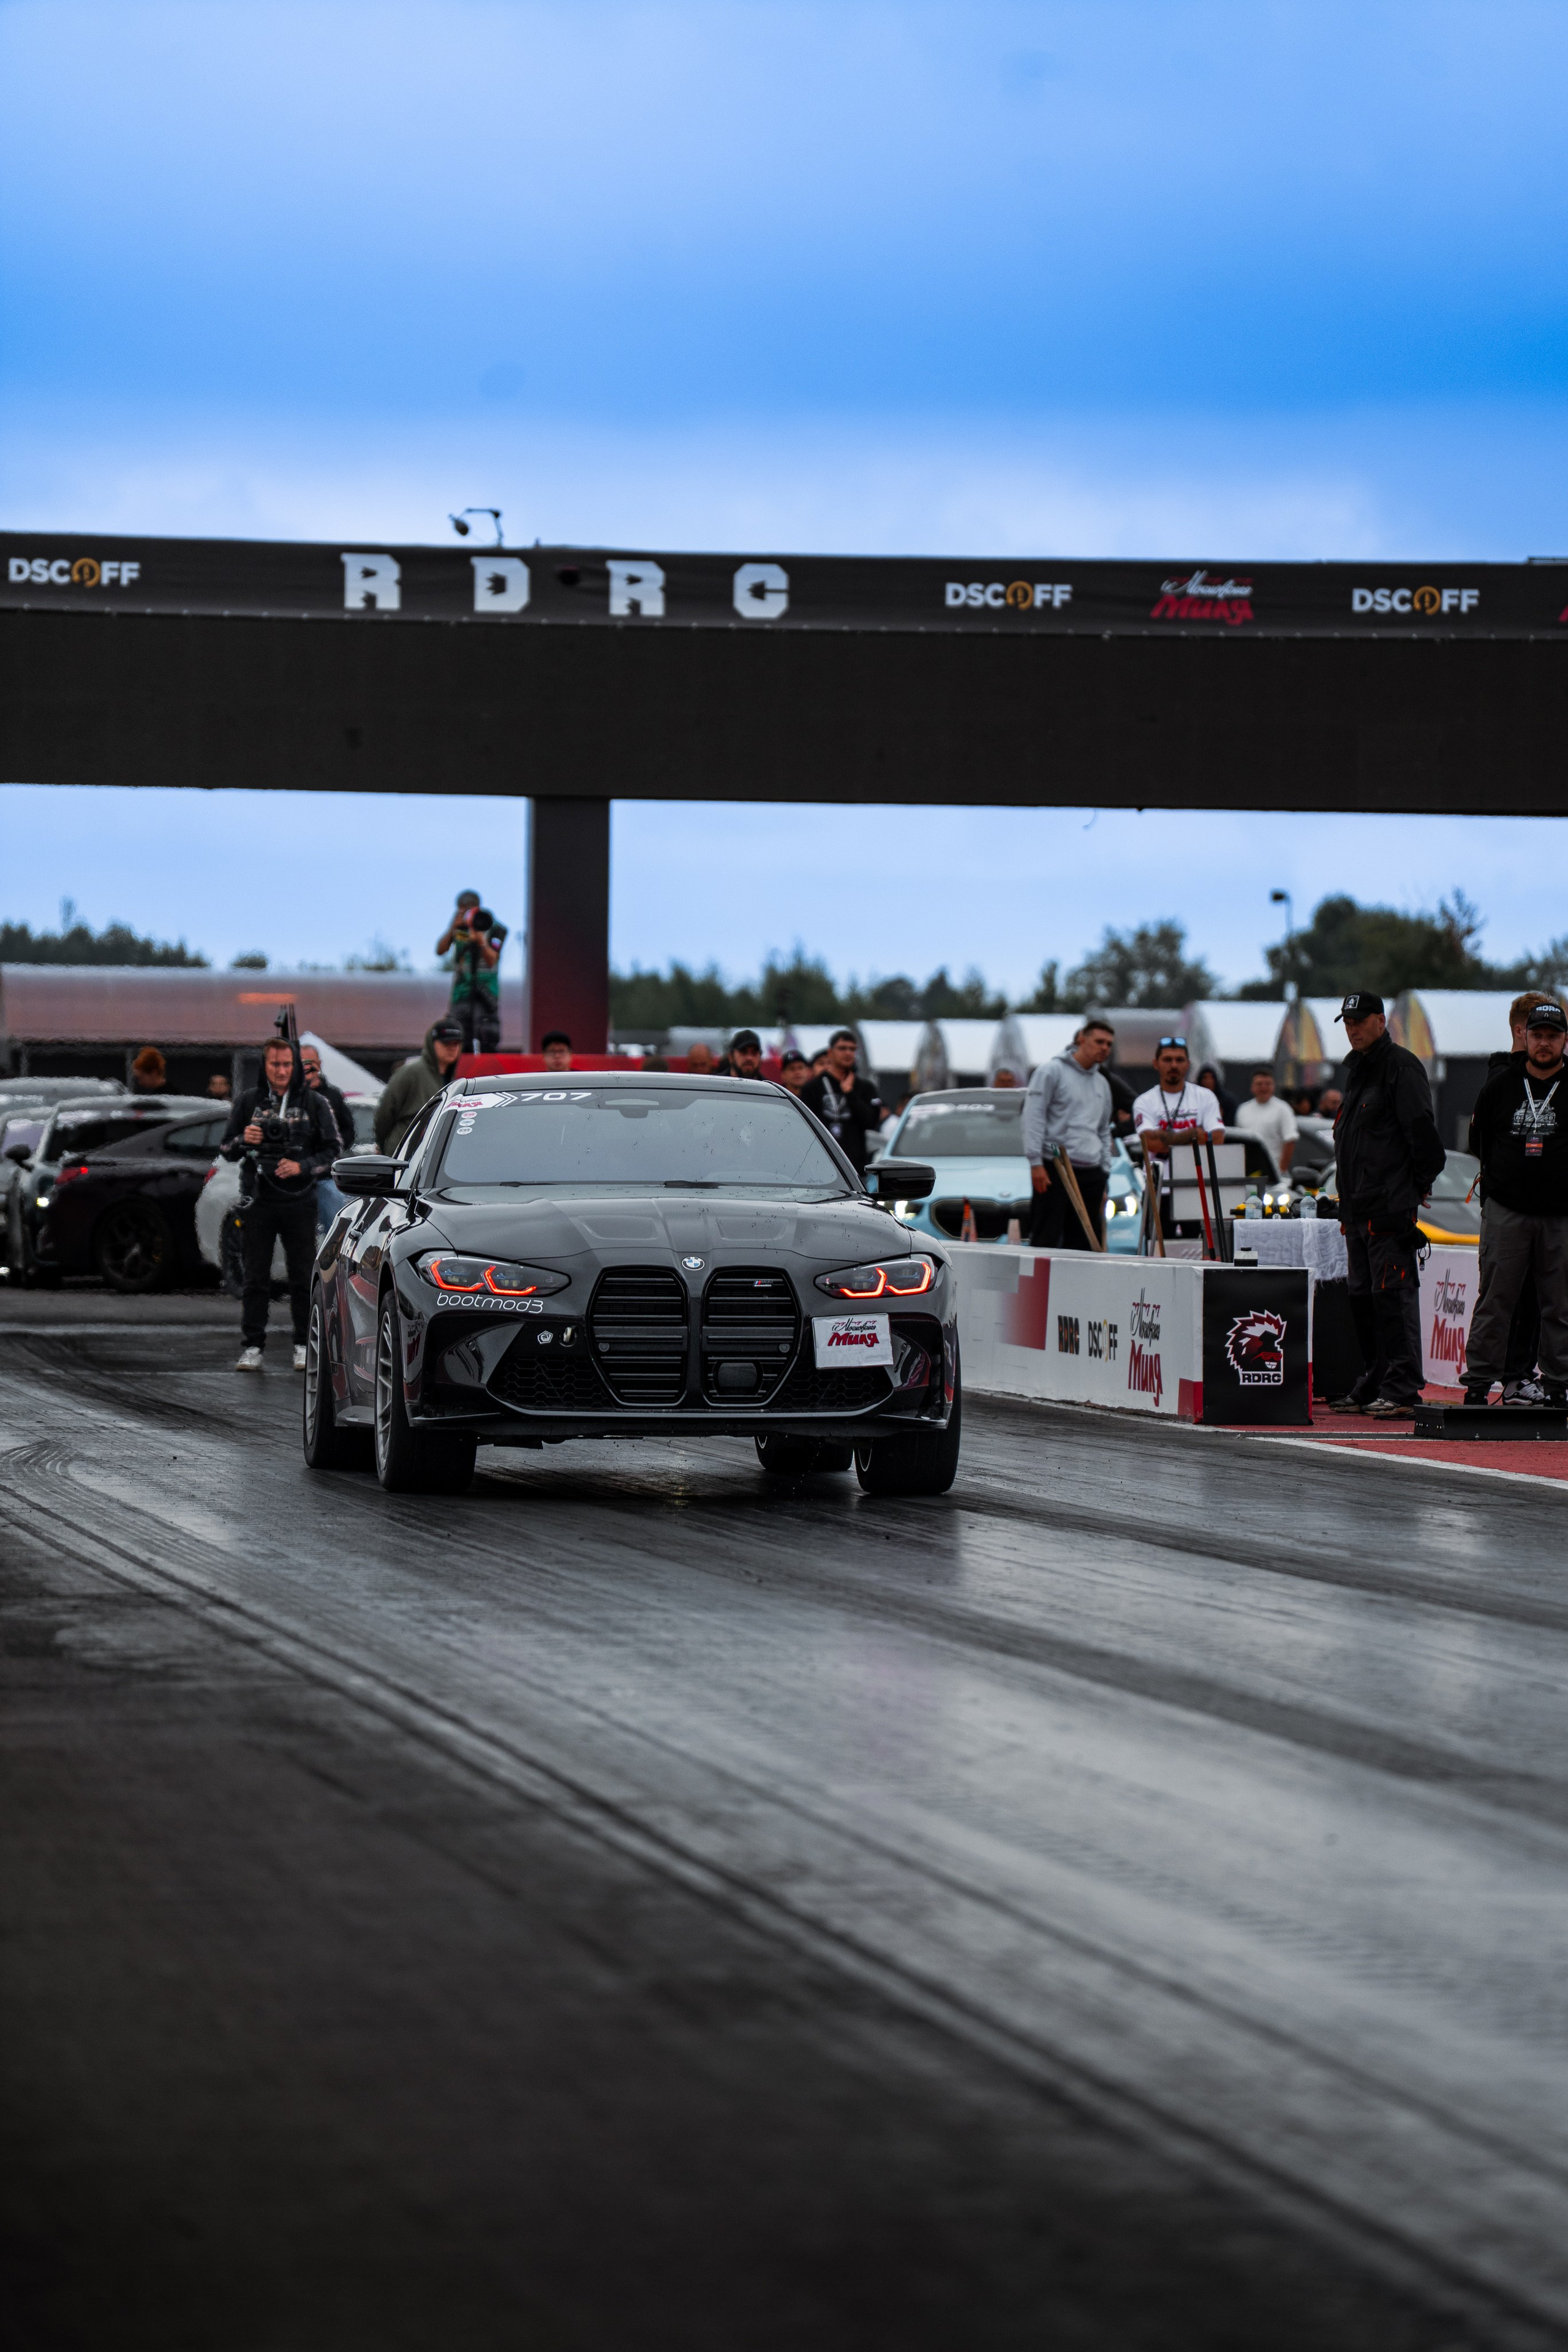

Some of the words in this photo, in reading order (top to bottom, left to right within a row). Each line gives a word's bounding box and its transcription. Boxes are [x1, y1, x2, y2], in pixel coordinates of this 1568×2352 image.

[8, 557, 141, 587] DSCOFF
[944, 580, 1072, 609] DSCOFF
[1351, 586, 1480, 615] DSCOFF
[521, 1092, 592, 1101] 707
[436, 1292, 544, 1314] bootmod3
[827, 1332, 880, 1348] Миля
[1242, 1373, 1281, 1383] RDRC
